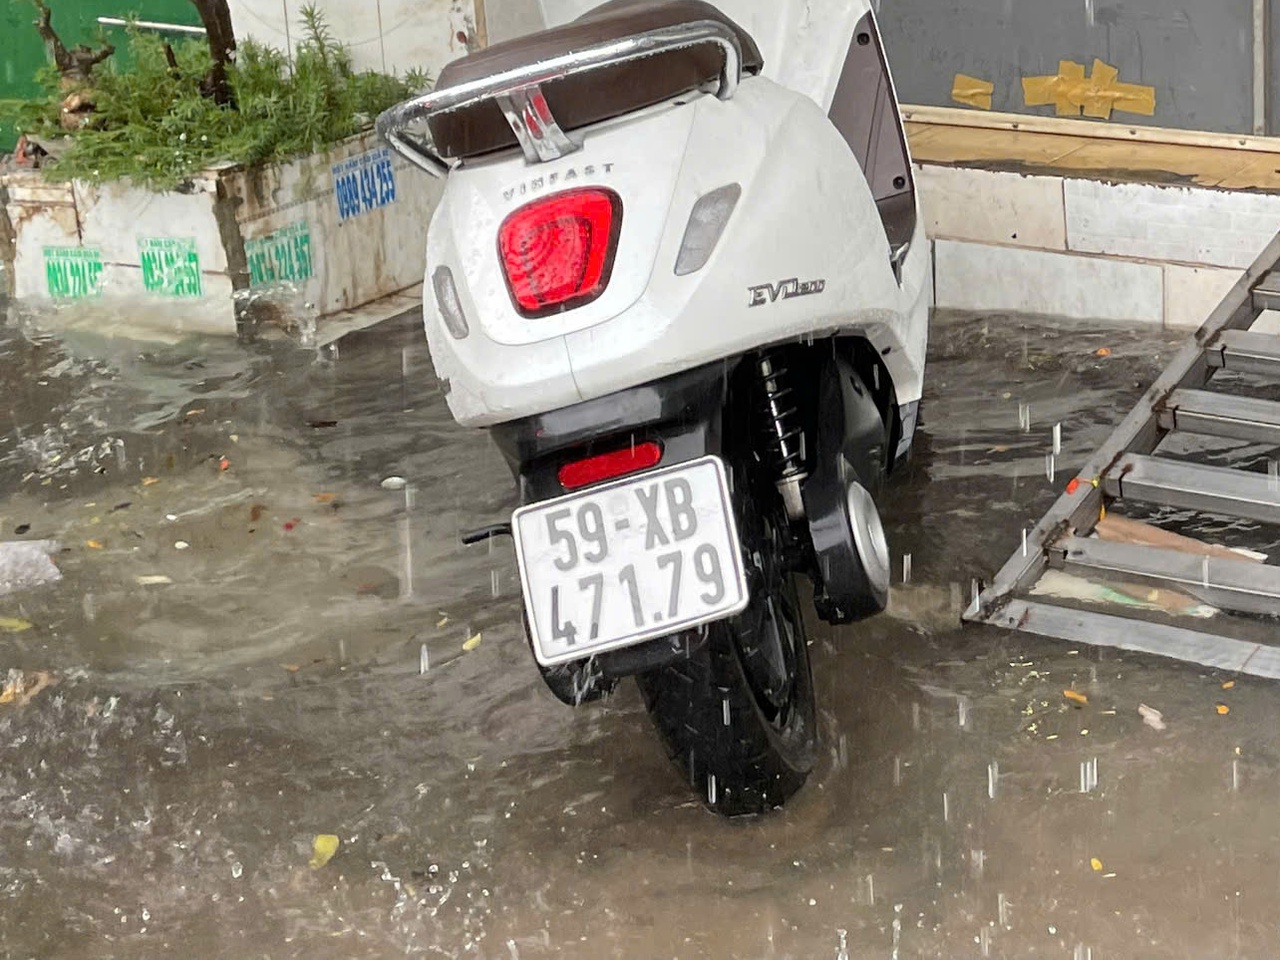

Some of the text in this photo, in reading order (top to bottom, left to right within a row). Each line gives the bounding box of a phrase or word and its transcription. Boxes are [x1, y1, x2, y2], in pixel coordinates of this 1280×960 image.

[503, 163, 614, 201] VINFAST
[545, 477, 698, 571] 59-XB
[550, 543, 725, 646] 471.79
